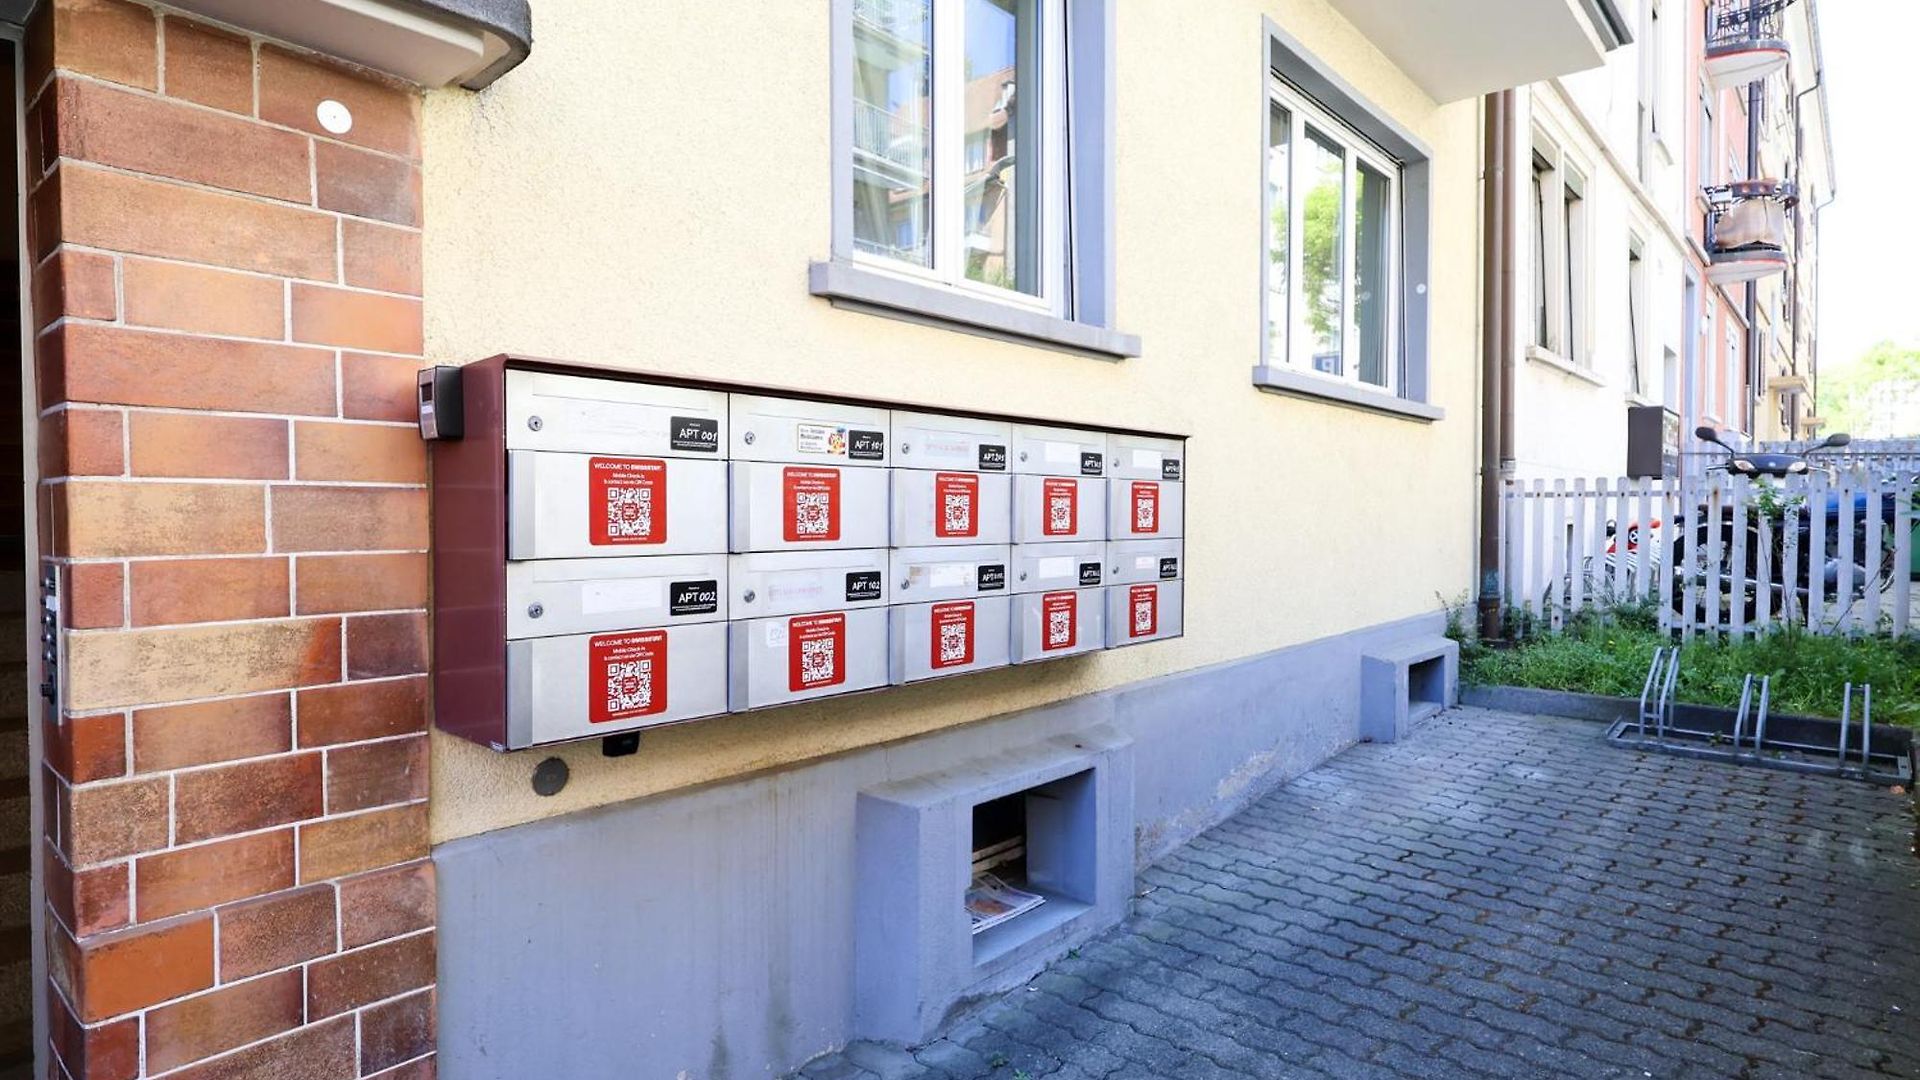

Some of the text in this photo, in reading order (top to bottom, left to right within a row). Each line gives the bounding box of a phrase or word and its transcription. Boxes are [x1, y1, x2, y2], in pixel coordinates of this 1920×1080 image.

[679, 427, 717, 441] APT 001
[854, 440, 870, 450] APT
[983, 452, 994, 461] APT
[982, 573, 994, 582] APT
[852, 581, 867, 591] APT
[678, 591, 716, 603] APT 002
[594, 638, 623, 647] WELCOME
